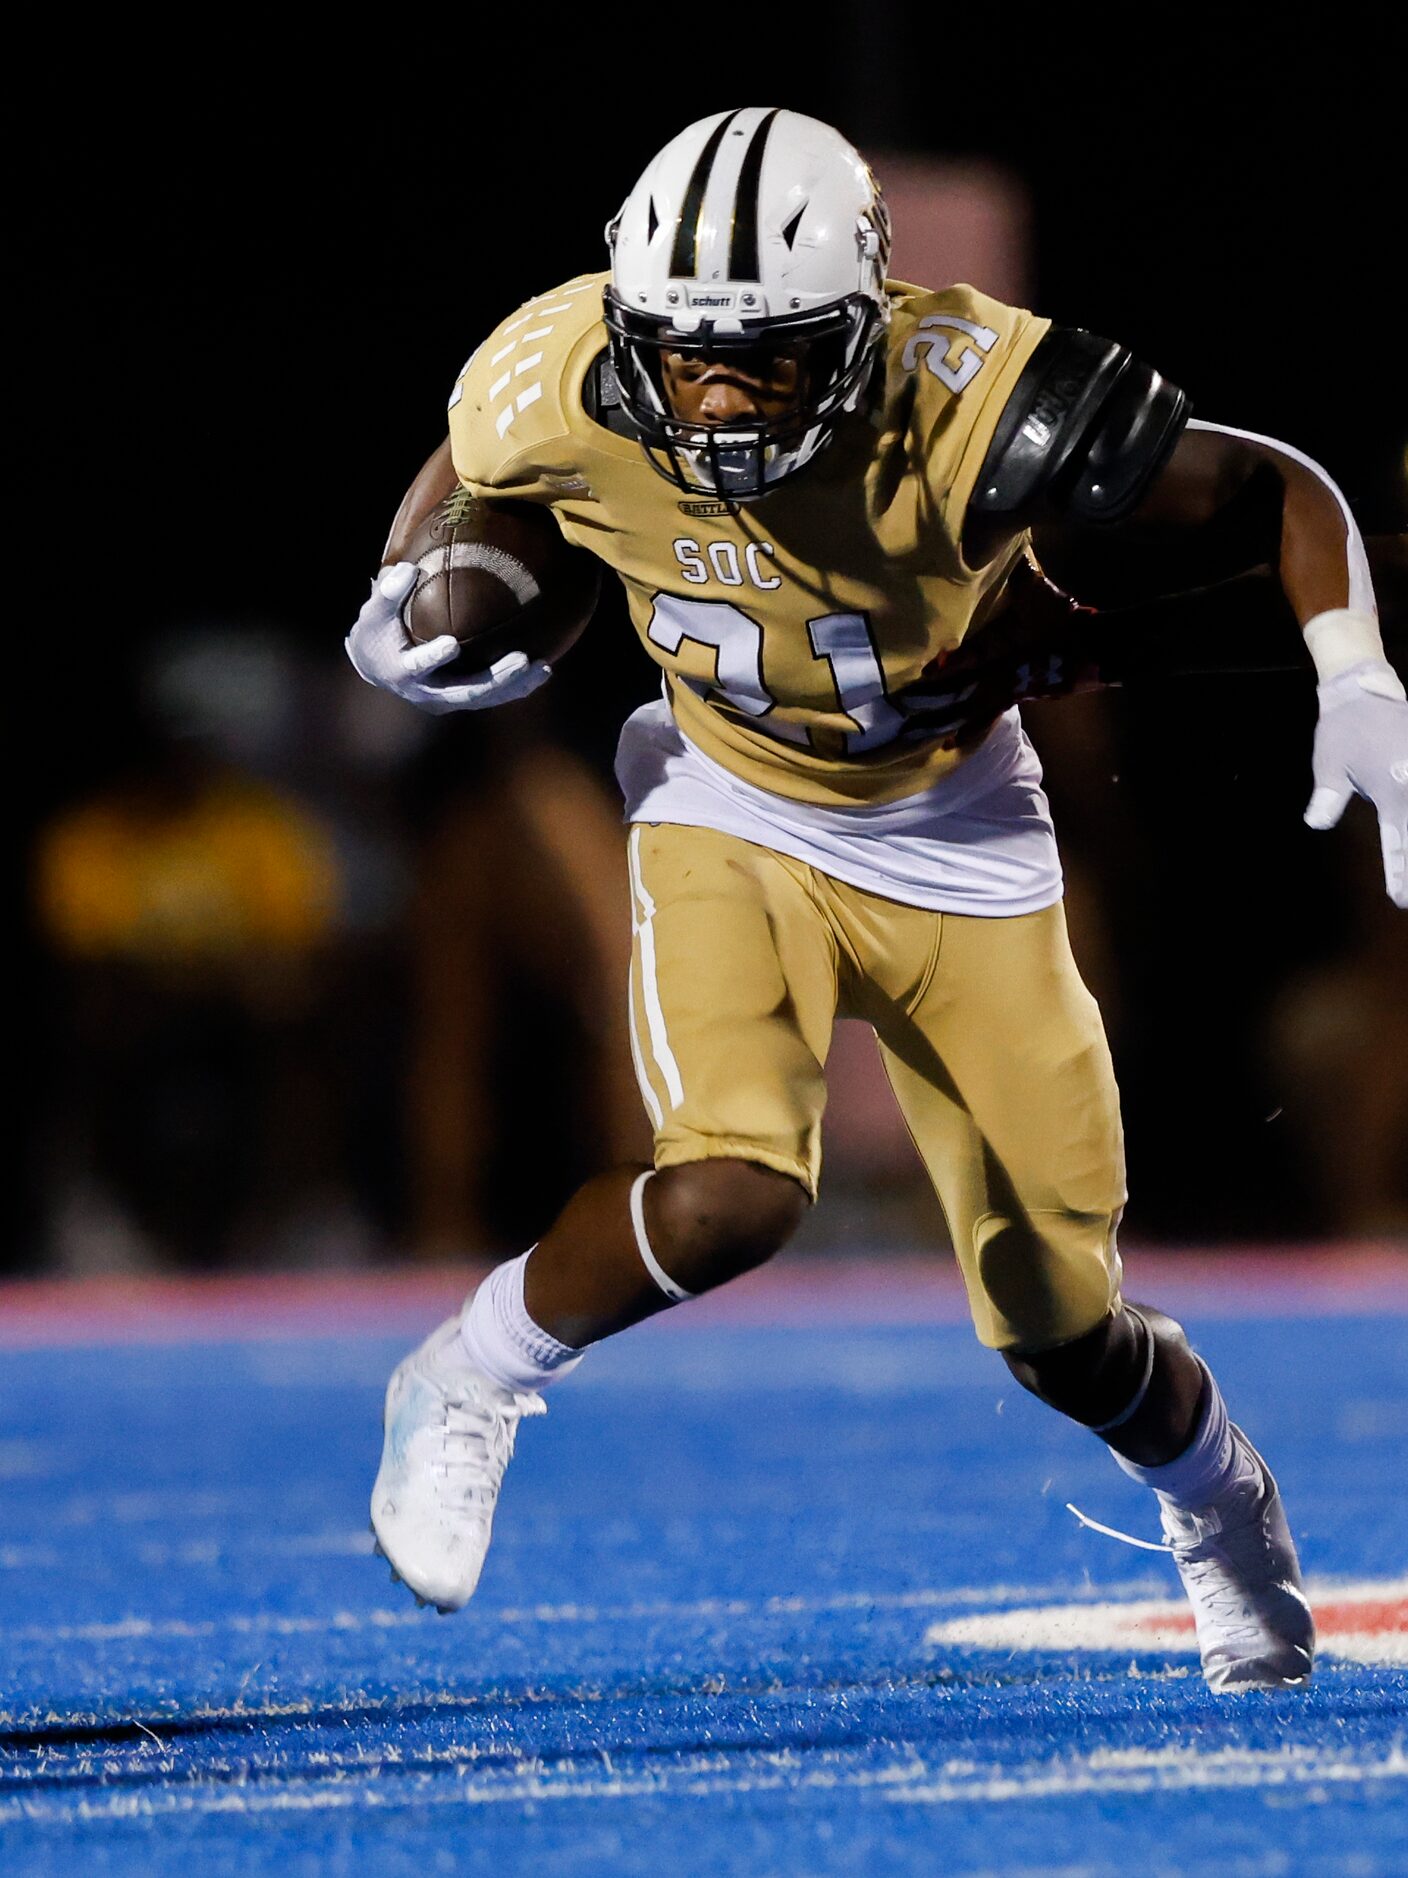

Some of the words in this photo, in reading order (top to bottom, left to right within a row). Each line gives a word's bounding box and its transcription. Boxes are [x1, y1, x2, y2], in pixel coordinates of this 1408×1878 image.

[691, 296, 731, 307] schutt
[902, 315, 999, 394] 21
[673, 538, 782, 590] SOC
[648, 590, 906, 757] 21
